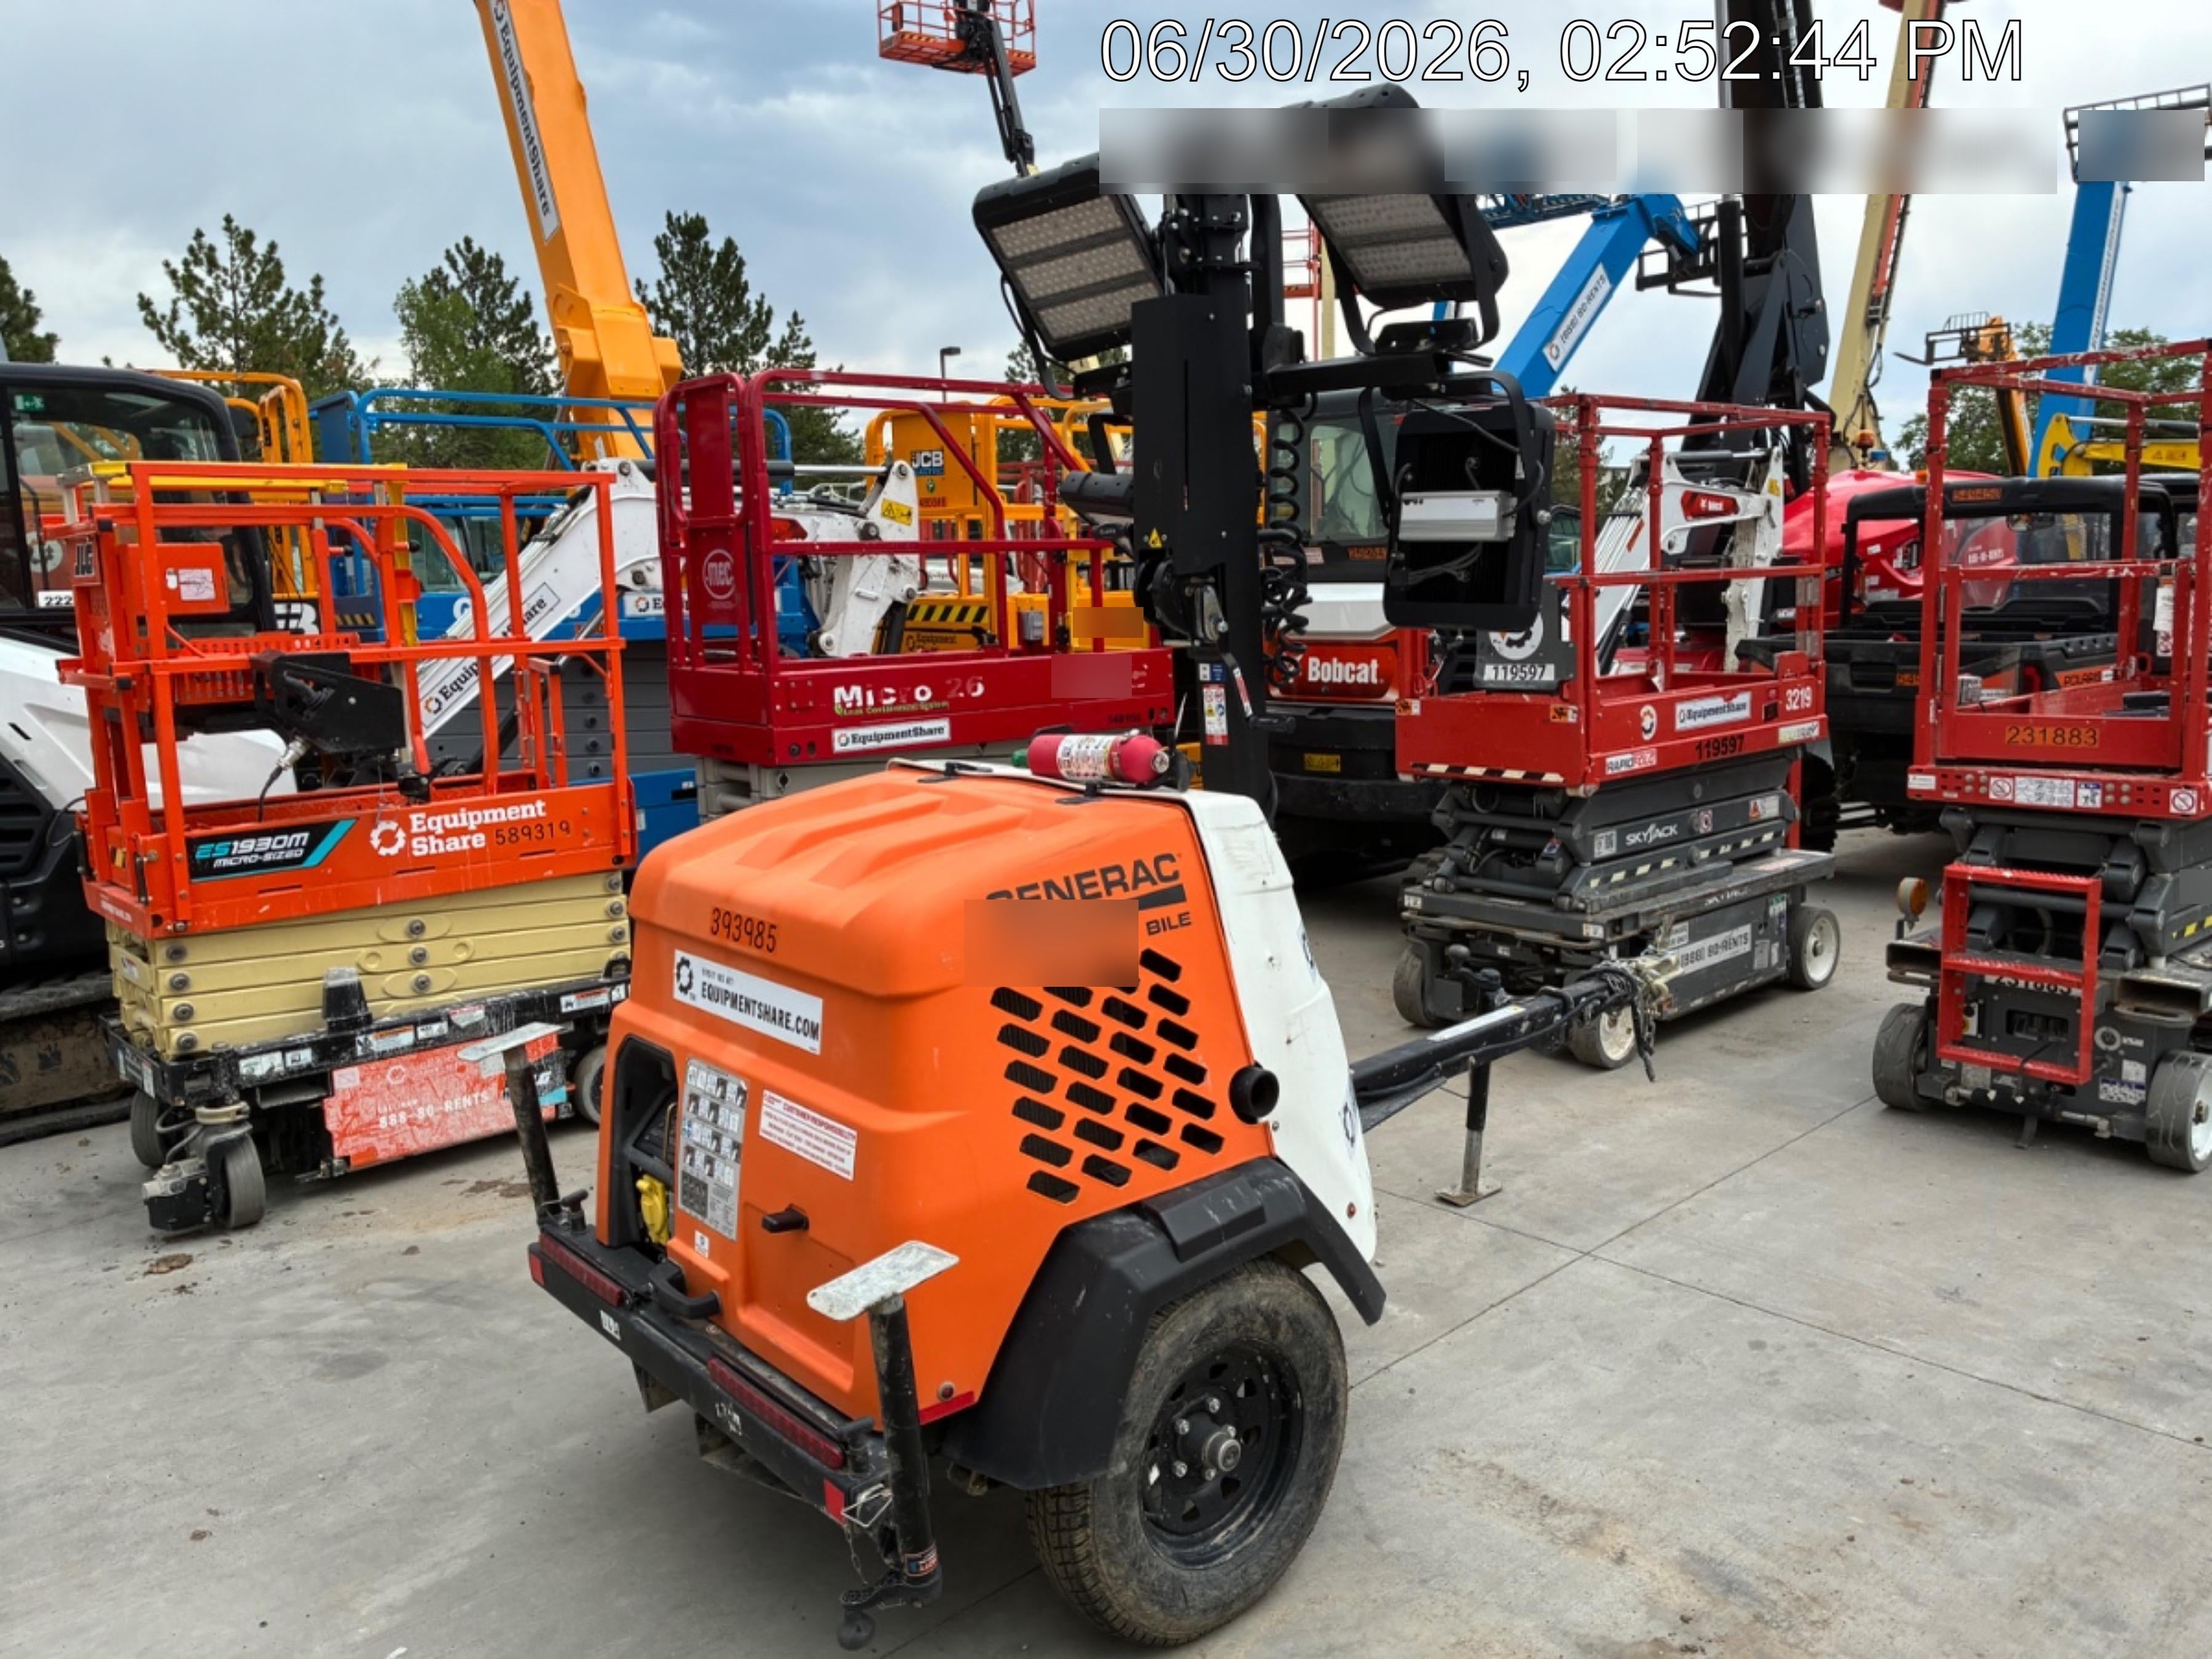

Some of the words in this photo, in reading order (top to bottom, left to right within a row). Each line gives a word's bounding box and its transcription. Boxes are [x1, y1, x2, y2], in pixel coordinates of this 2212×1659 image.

[499, 23, 550, 217] EquipmentShare
[911, 450, 943, 468] JCB
[1308, 657, 1378, 684] Bobcat
[1492, 665, 1546, 680] 119597
[1687, 702, 1747, 721] EquipmentShare
[1786, 687, 1812, 711] 3219
[851, 726, 944, 745] EquipmentShare
[1696, 735, 1744, 760] 119597
[2007, 726, 2098, 746] 231883
[409, 799, 546, 834] Equipment
[195, 831, 310, 860] ES1930M
[412, 831, 486, 856] Share
[495, 820, 570, 846] 589319
[1626, 823, 1678, 846] SKYJACK
[213, 848, 305, 868] MICRO-SIZED
[711, 907, 777, 953] 393985
[701, 981, 820, 1041] EQUIPMENTSHARE.COM
